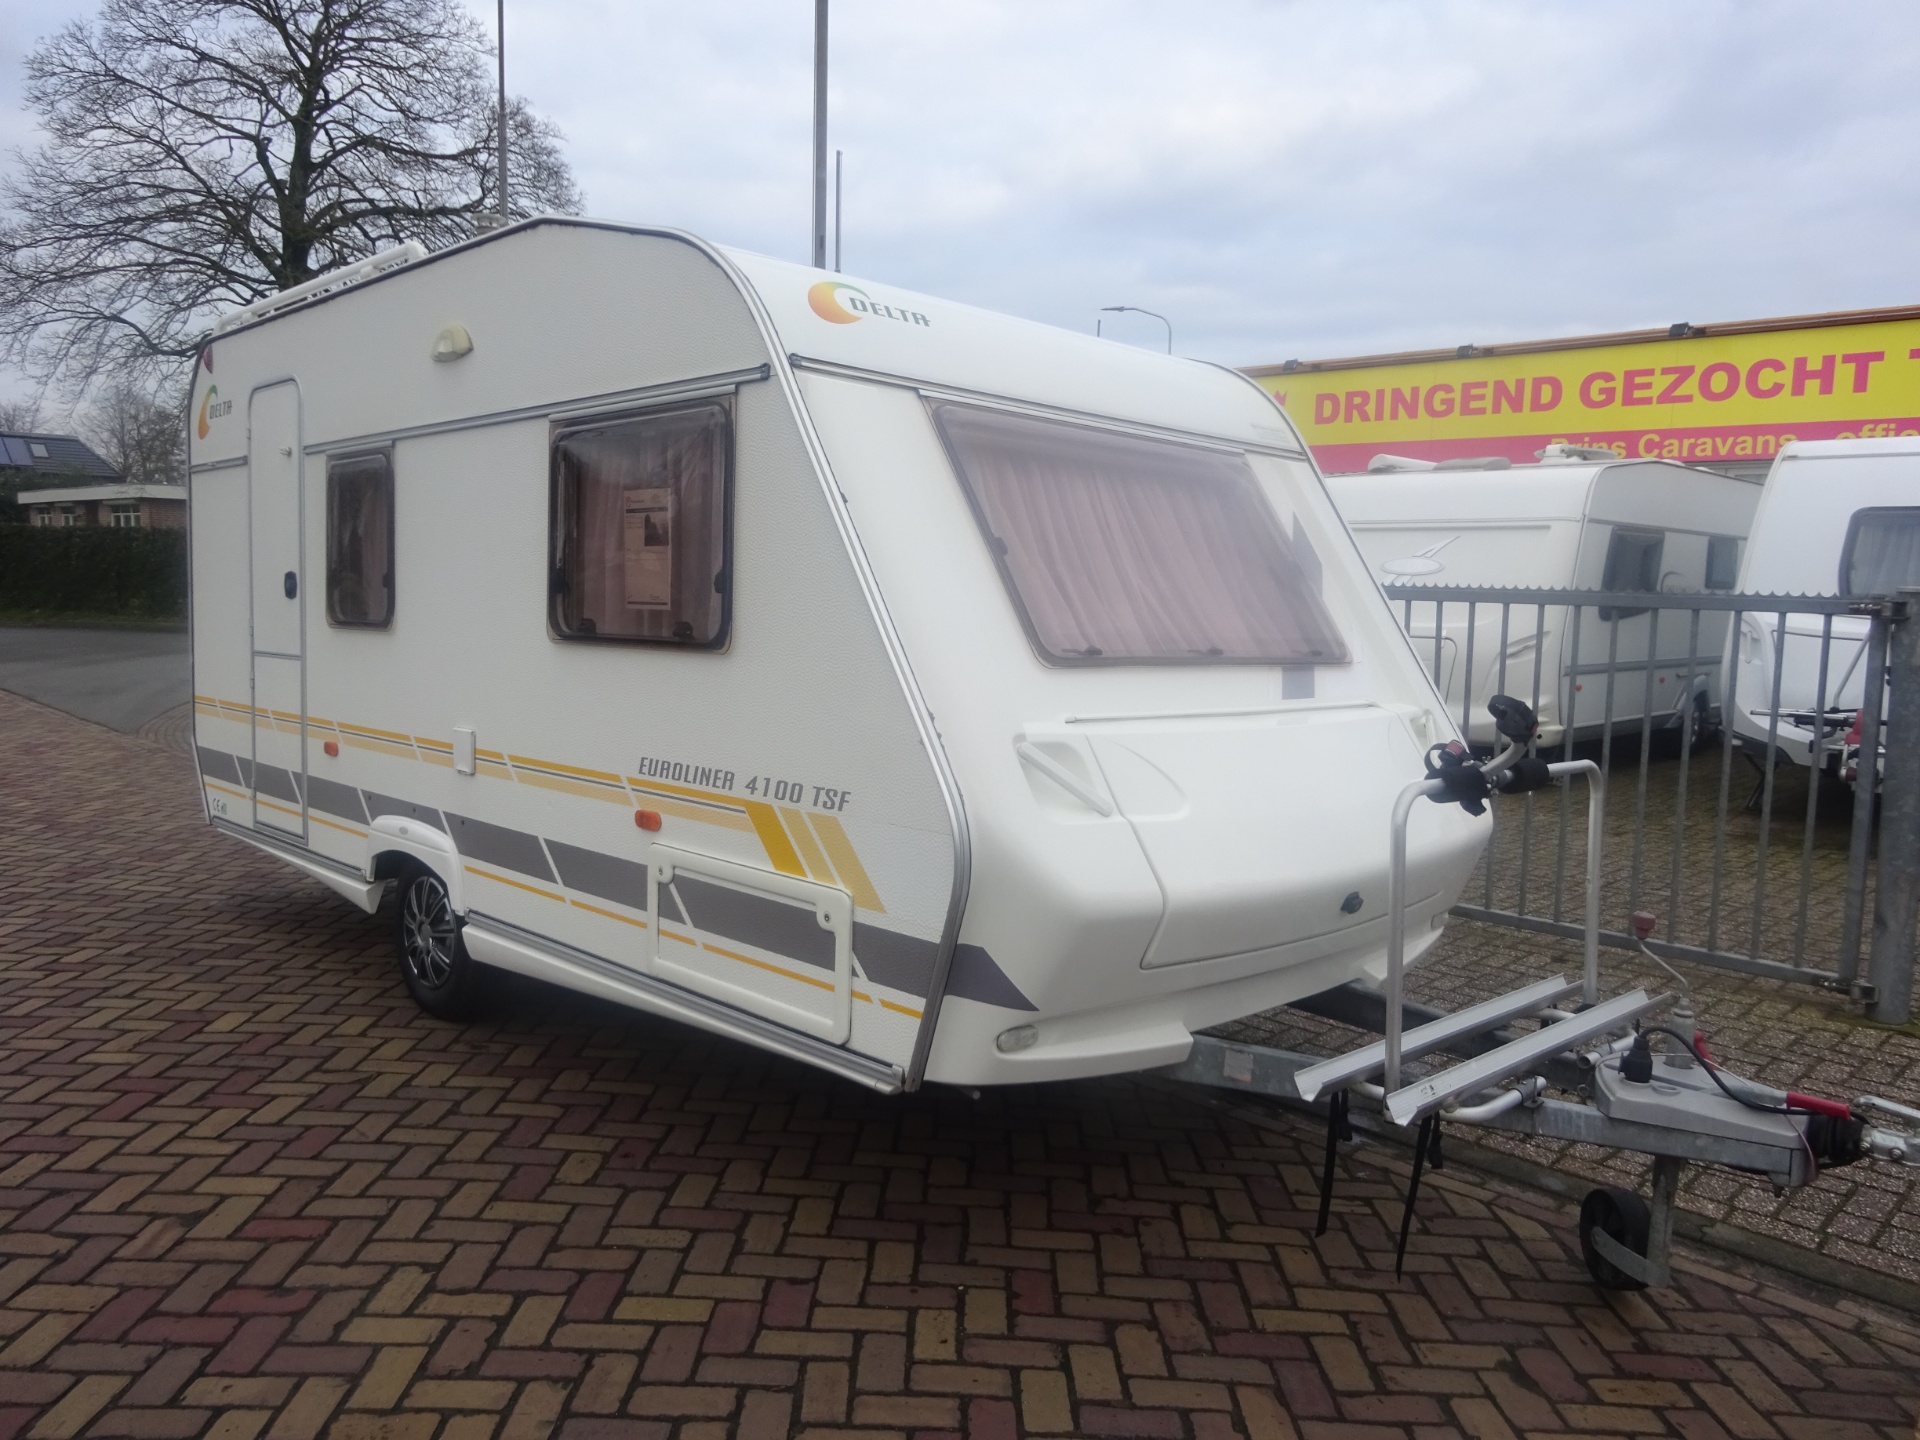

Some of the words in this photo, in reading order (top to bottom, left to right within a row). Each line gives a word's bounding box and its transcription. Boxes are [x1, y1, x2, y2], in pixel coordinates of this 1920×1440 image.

[849, 297, 931, 327] DELTA
[1314, 376, 1563, 425] DRINGEND
[1579, 351, 1885, 409] GEZOCHT
[209, 400, 232, 420] DELTA
[638, 756, 735, 791] EUROLINER
[744, 776, 804, 804] 4100
[812, 786, 852, 812] TSF
